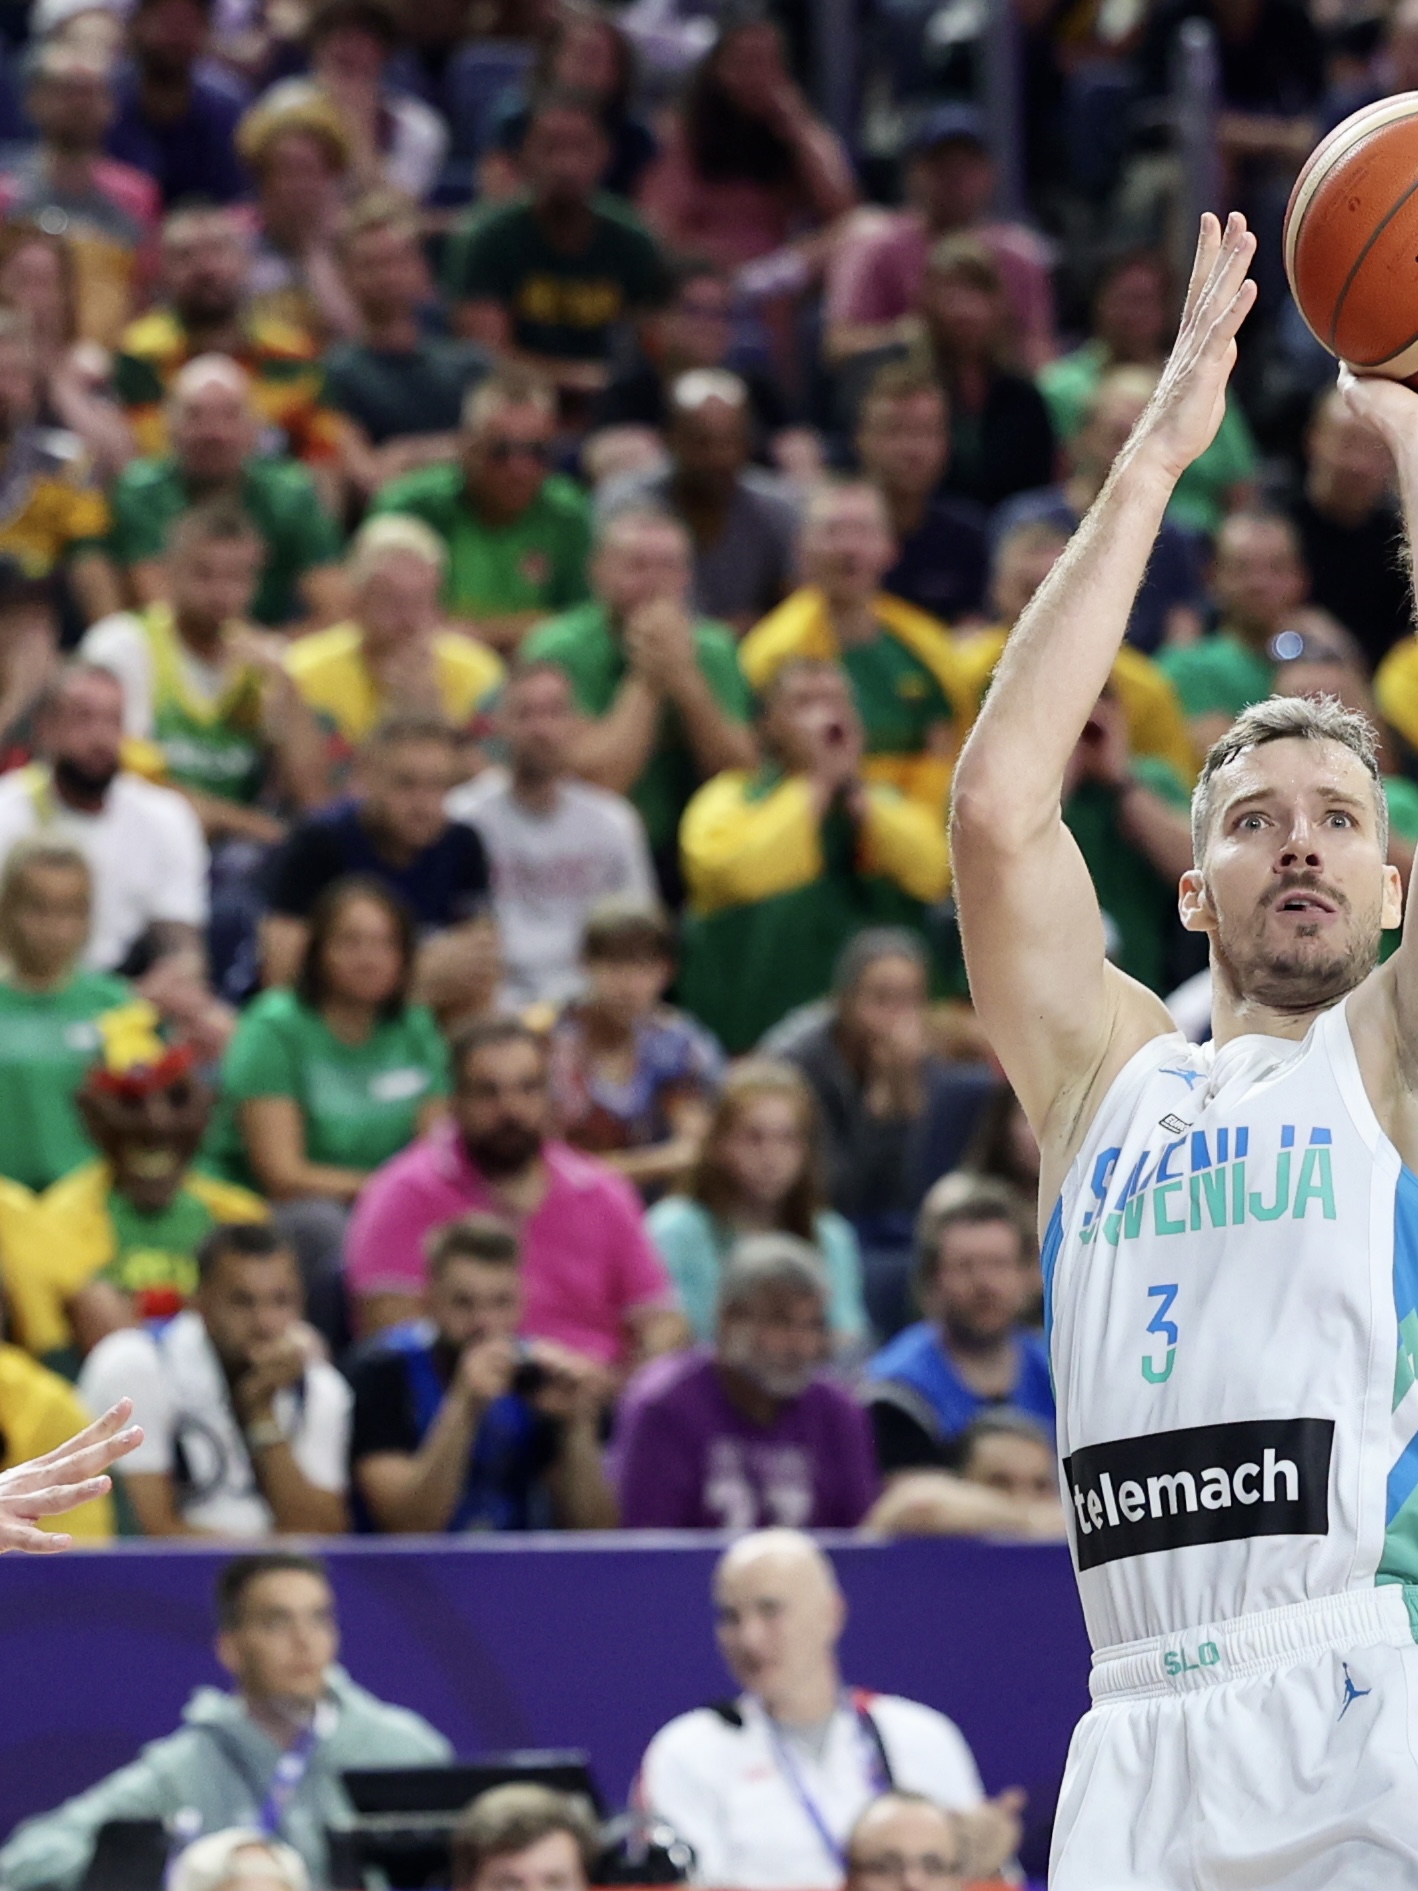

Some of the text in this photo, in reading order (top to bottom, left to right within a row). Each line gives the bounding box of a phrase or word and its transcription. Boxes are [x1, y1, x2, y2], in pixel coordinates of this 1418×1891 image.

[1141, 1284, 1178, 1384] 3
[1074, 1448, 1299, 1535] telemach
[1163, 1641, 1220, 1676] SLO
